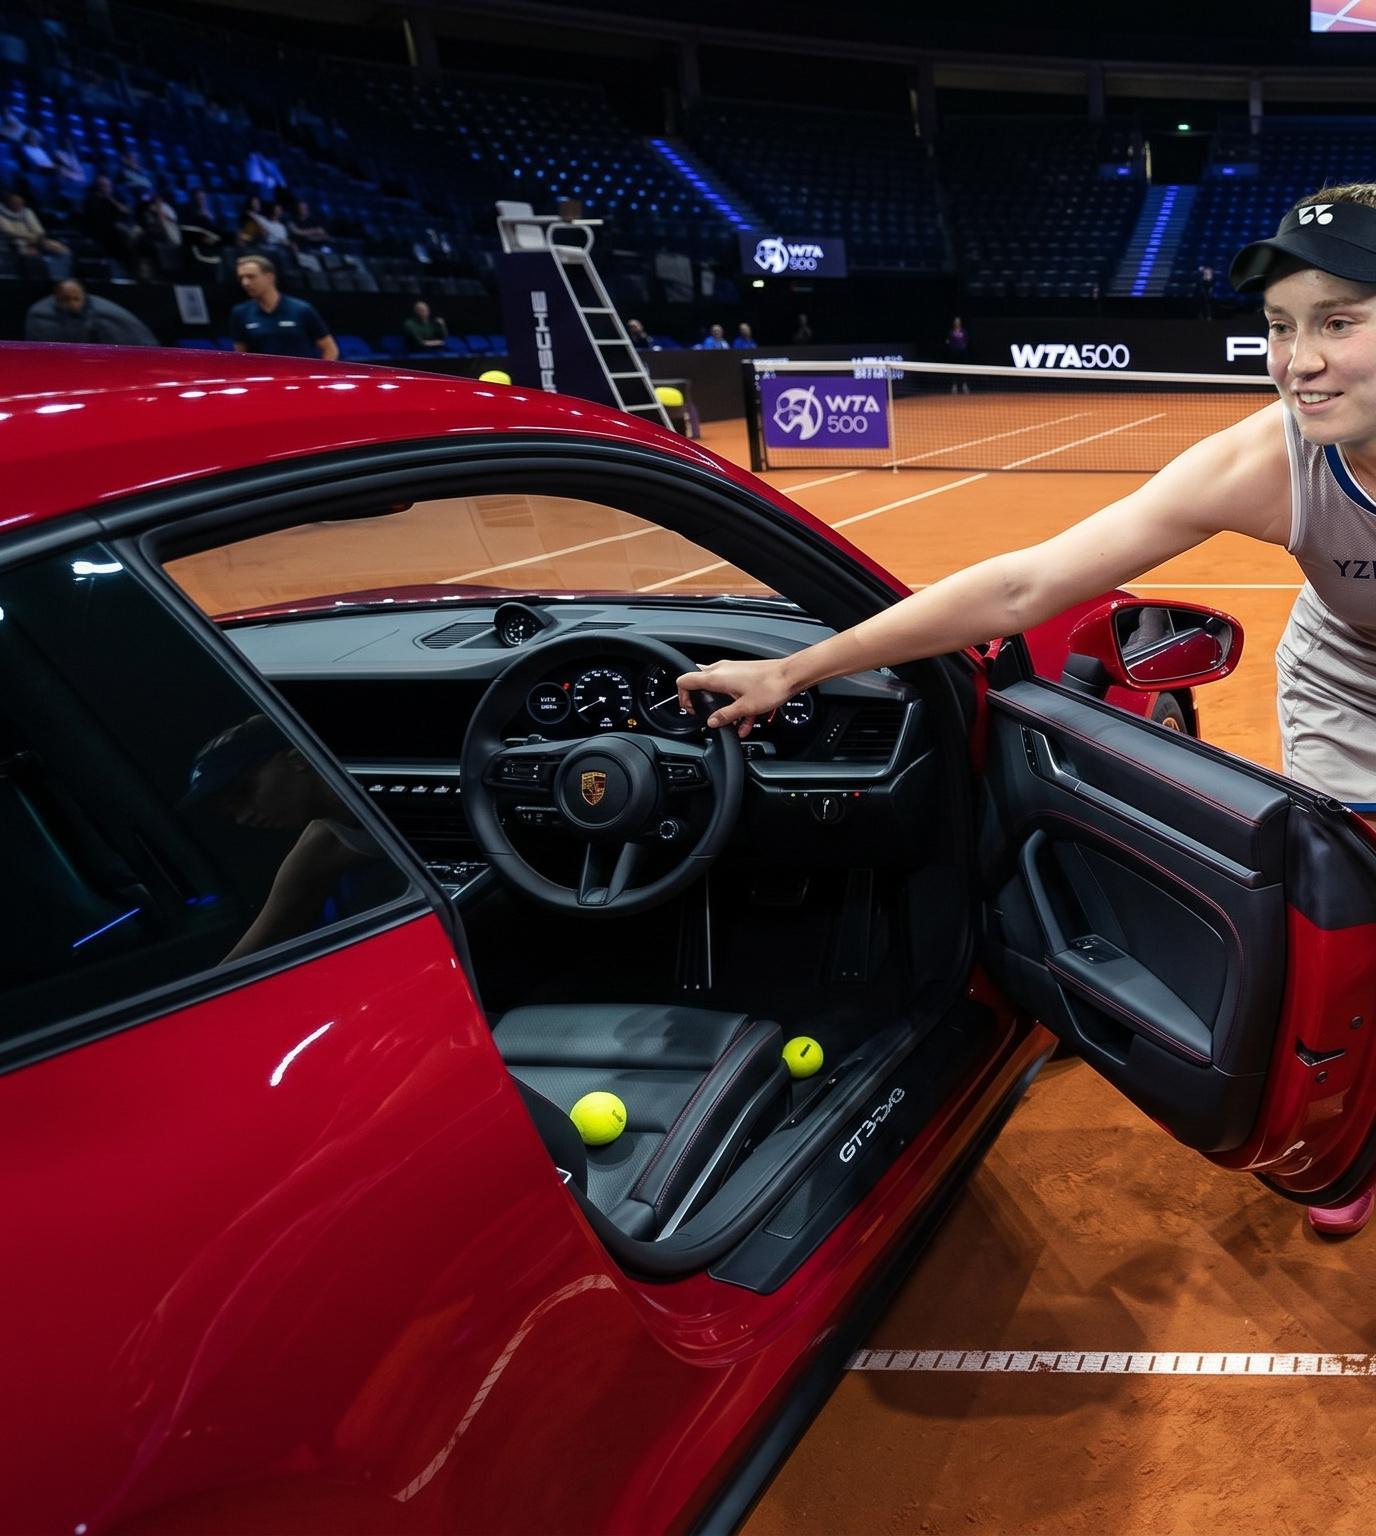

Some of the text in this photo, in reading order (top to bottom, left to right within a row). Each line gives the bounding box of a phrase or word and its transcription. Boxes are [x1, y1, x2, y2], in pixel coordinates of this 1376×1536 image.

[787, 244, 824, 258] WTA
[1010, 344, 1130, 368] WTA500
[825, 395, 881, 413] WTA
[827, 415, 868, 434] 500
[839, 1120, 877, 1163] GT3
